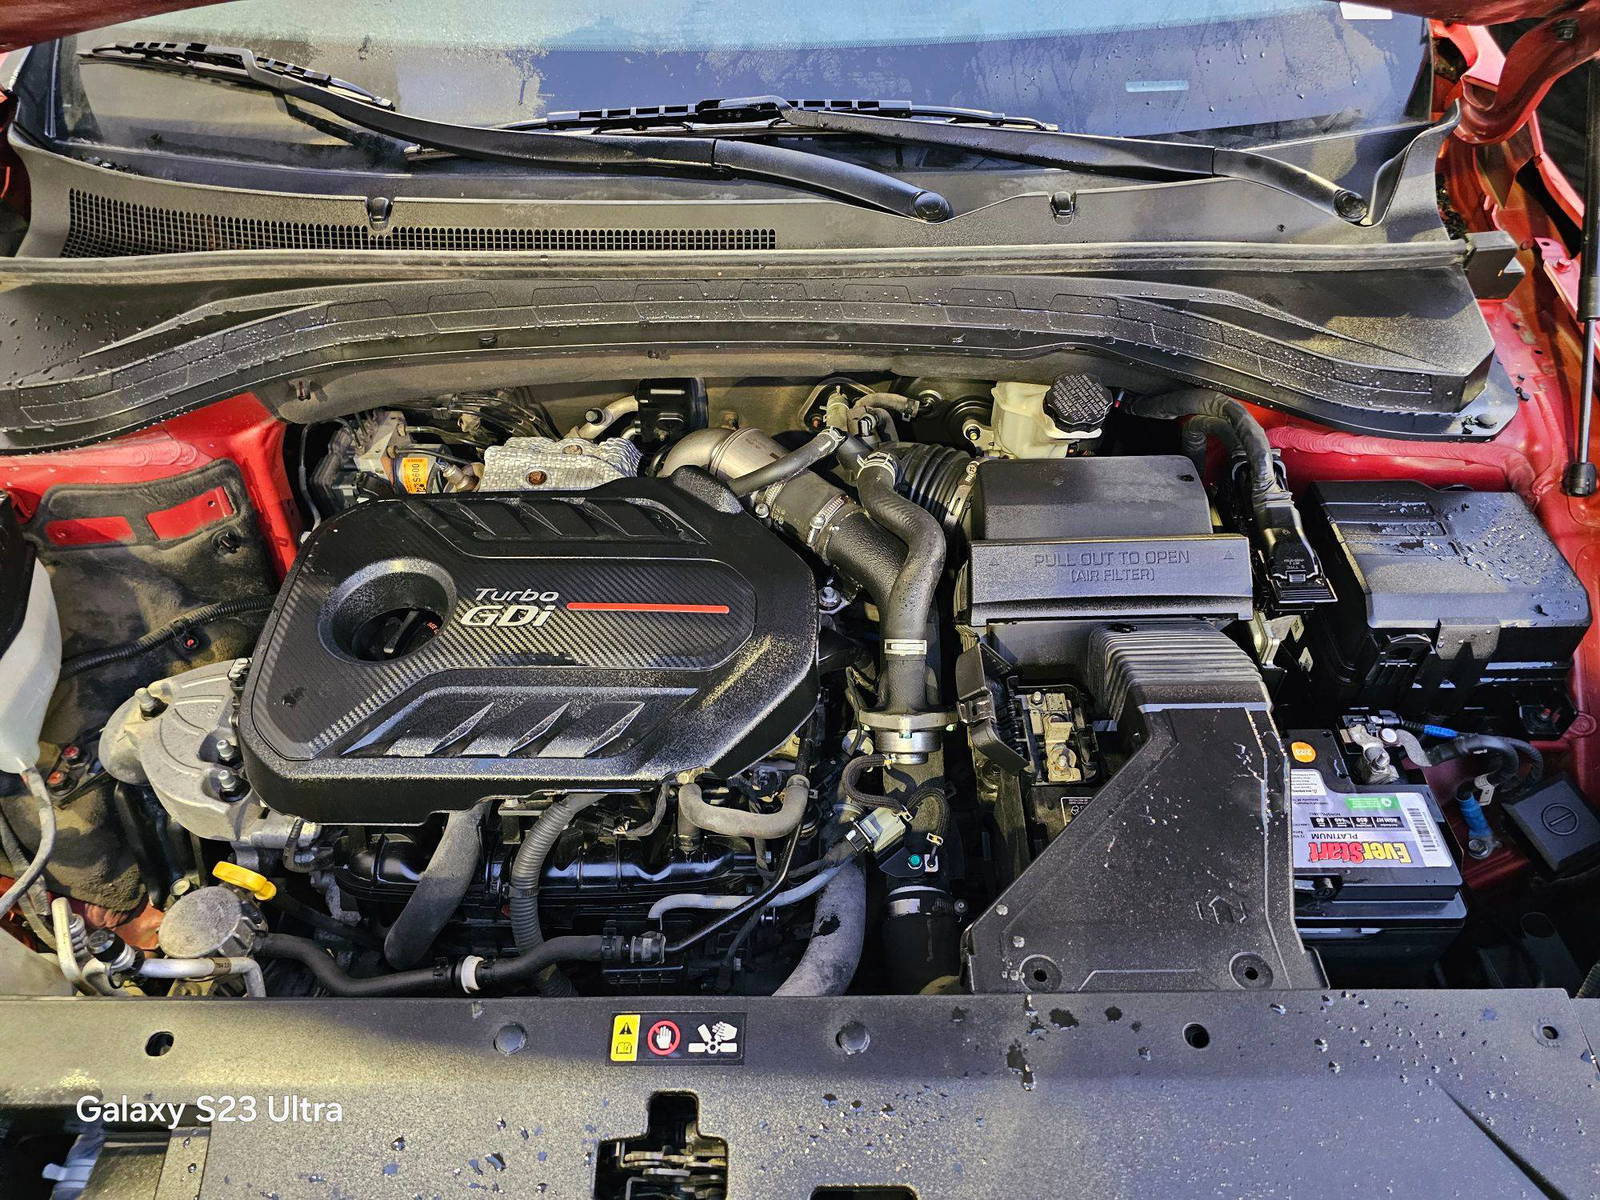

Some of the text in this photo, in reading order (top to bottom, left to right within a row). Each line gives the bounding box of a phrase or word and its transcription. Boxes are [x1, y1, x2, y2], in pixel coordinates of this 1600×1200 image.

[1034, 550, 1190, 567] PULL OUT TO OPEN
[1071, 568, 1155, 583] (AIR FILTER)
[475, 588, 559, 602] Turbo
[460, 605, 556, 627] GDi
[1311, 832, 1358, 840] PLATINUM
[1309, 841, 1412, 863] EverStart
